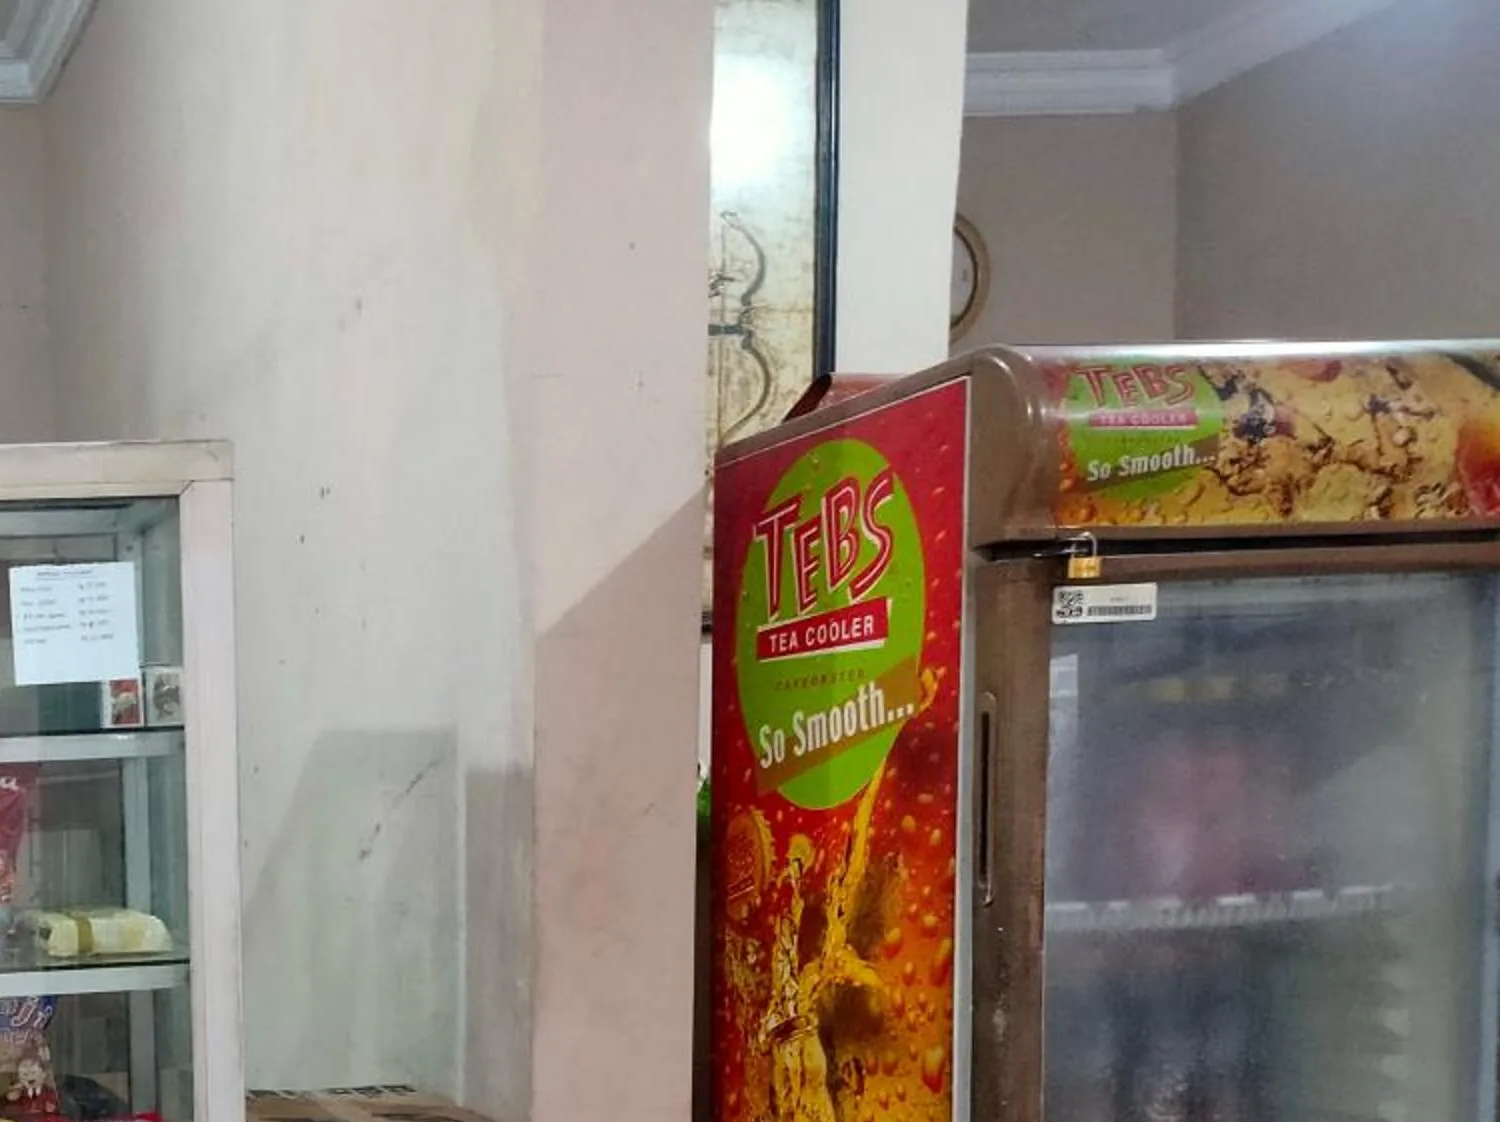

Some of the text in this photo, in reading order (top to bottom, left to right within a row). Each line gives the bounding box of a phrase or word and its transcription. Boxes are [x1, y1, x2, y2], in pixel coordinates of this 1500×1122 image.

[1074, 364, 1195, 409] TEBS
[1086, 460, 1111, 481] So
[752, 465, 895, 624] TEBS
[769, 613, 875, 653] TEA COOLER
[759, 681, 915, 769] So Smooth...
